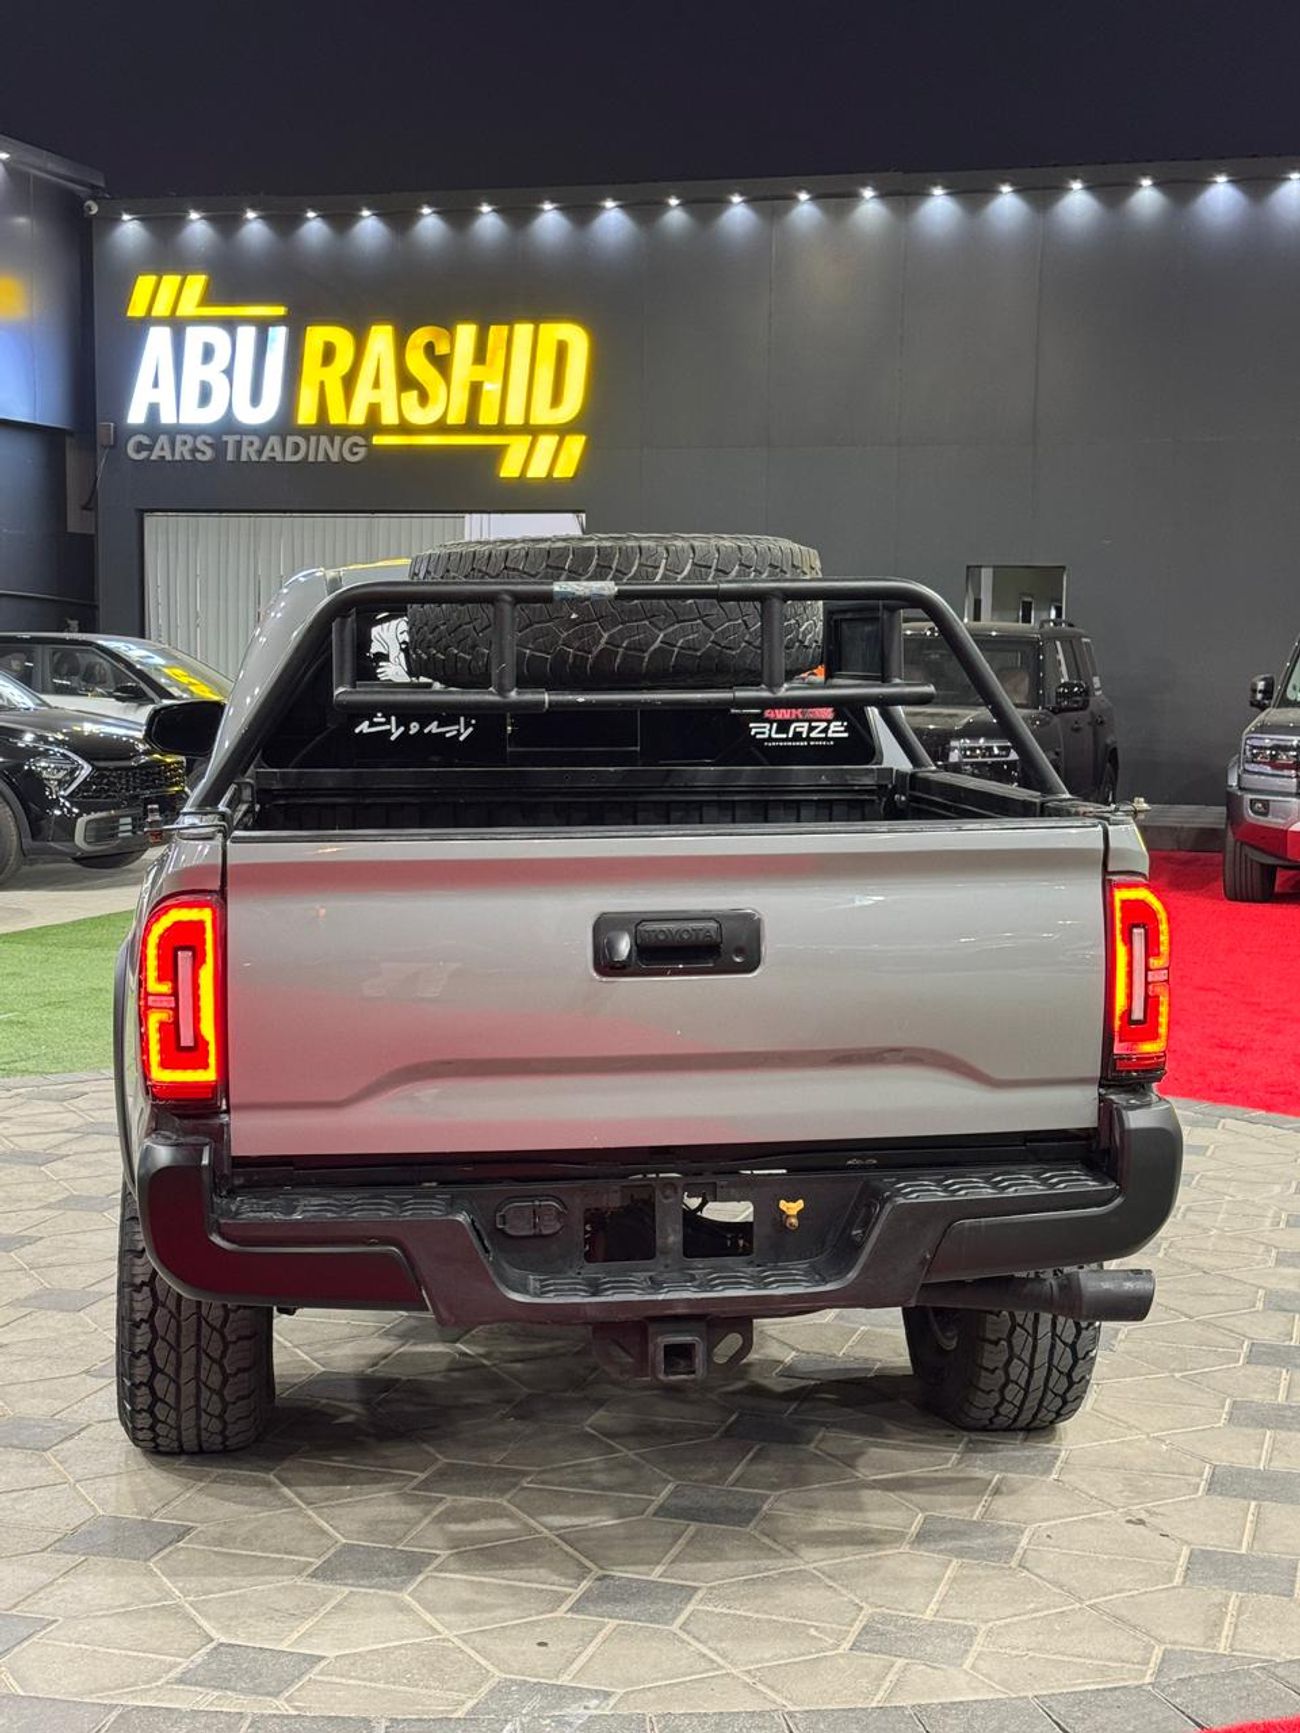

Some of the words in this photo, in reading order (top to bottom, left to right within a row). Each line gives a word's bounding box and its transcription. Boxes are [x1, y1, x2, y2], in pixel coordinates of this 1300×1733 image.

[126, 325, 288, 425] ABU
[296, 322, 589, 426] RASHID
[126, 434, 214, 463] CARS
[222, 434, 369, 464] TRADING
[749, 721, 849, 739] BLAZE
[643, 927, 714, 943] TOYOTA
